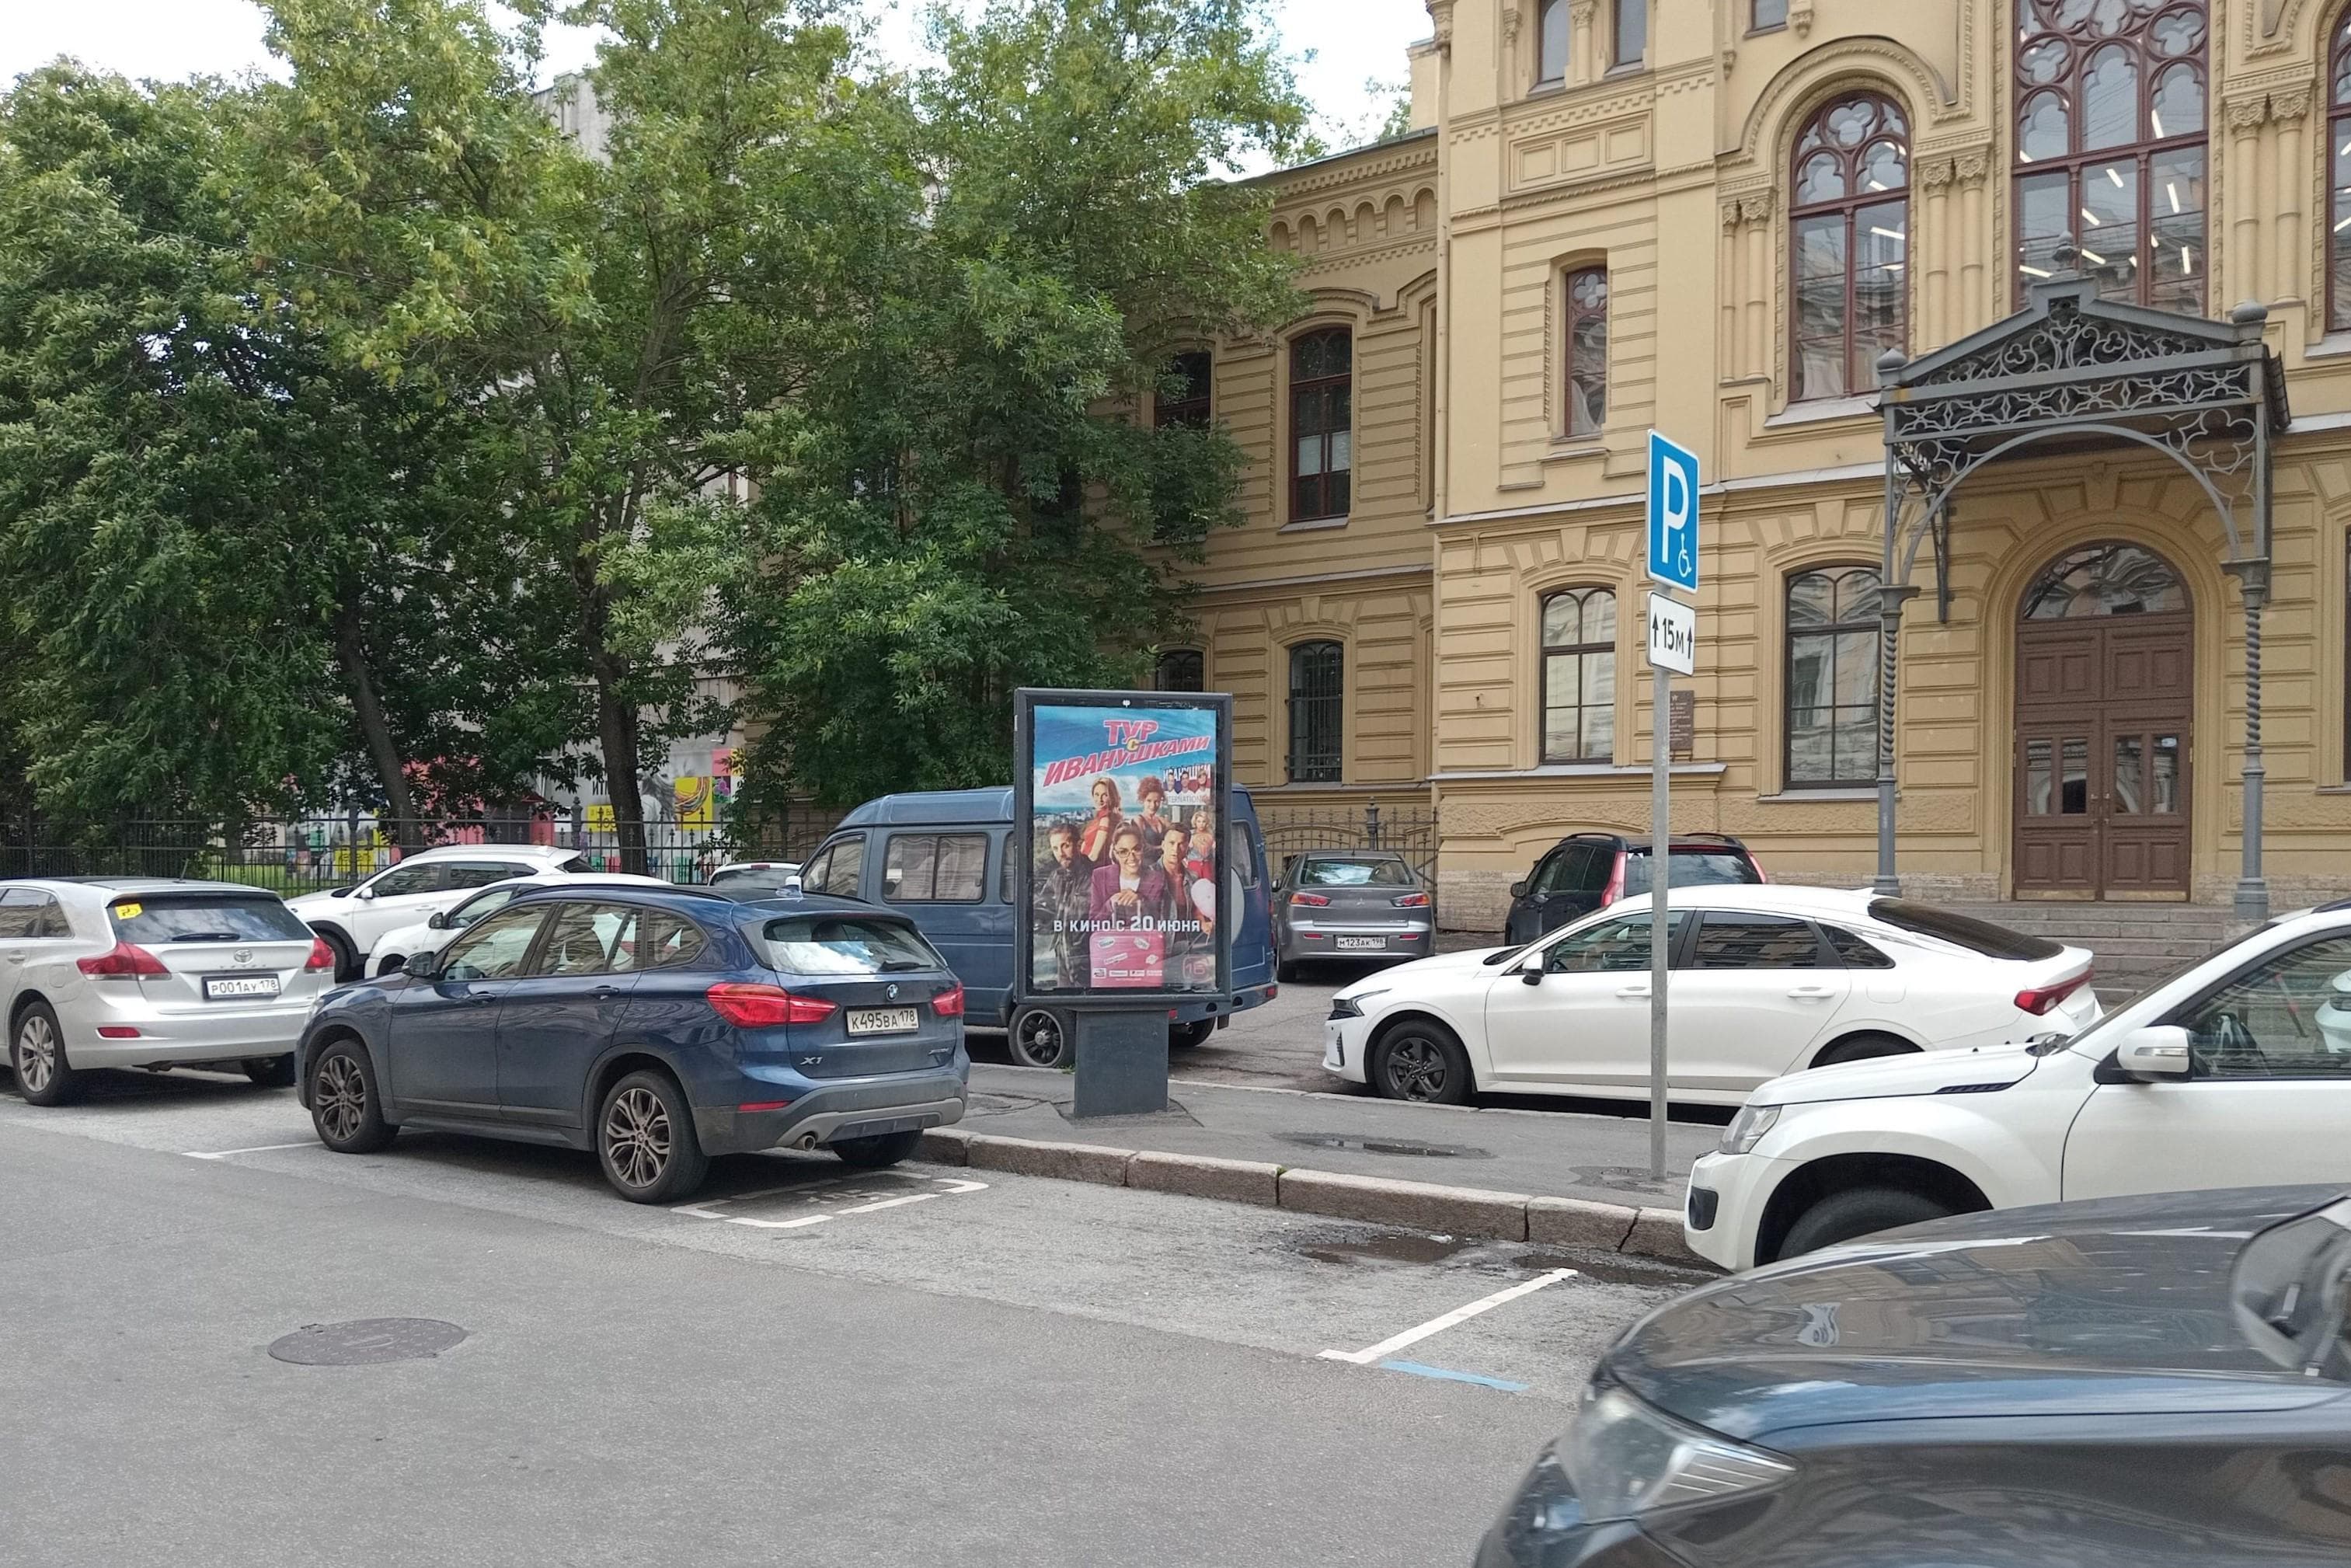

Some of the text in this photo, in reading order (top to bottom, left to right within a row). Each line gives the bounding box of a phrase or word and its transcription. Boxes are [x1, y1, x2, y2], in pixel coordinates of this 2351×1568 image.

[1661, 455, 1690, 564] P
[1103, 720, 1159, 746] ТУР
[1043, 735, 1212, 788] ИВАНУШКАМИ
[1054, 915, 1201, 932] В КИНО С 20 ИЮНЯ
[799, 1056, 824, 1065] X1
